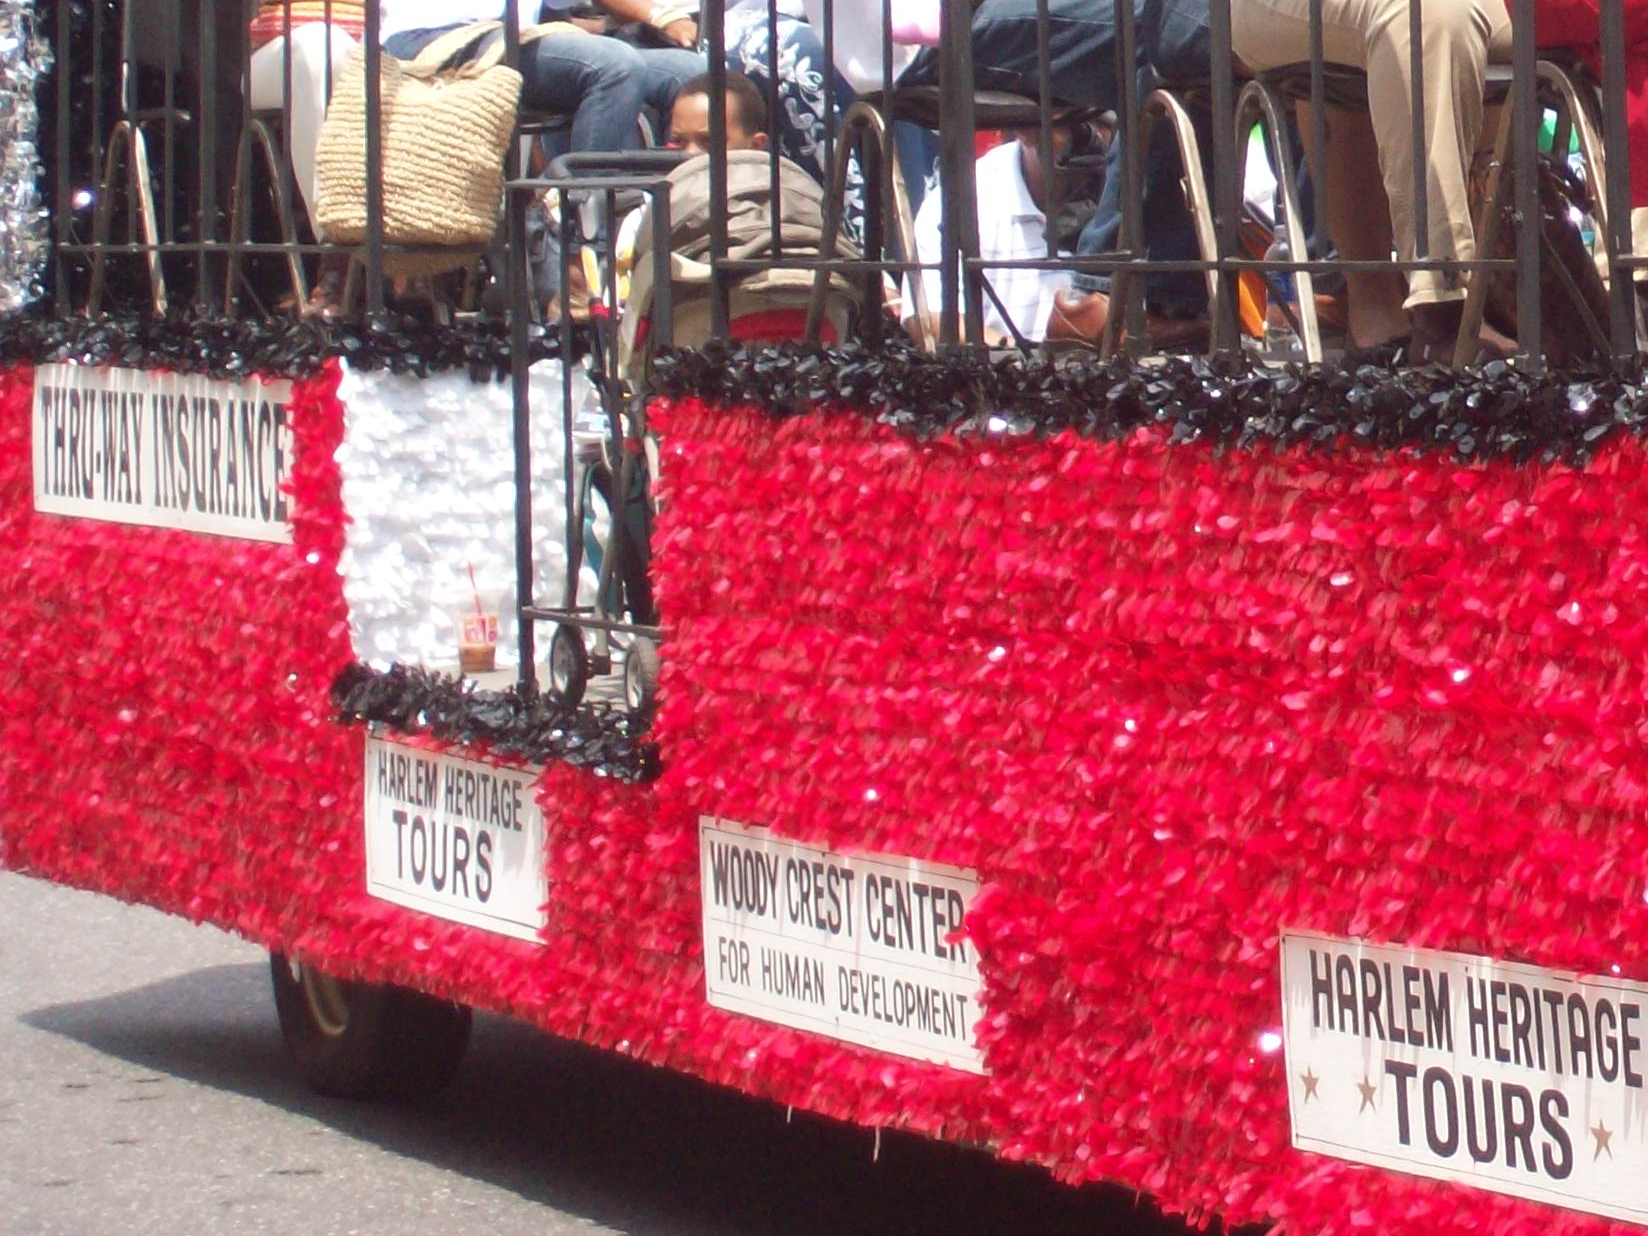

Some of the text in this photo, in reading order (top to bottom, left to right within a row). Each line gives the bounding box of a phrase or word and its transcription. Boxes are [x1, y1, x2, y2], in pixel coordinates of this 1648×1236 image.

[41, 385, 289, 523] THRU-WAY INSURANCE
[378, 749, 523, 832] HARLEM HERITAGE
[392, 809, 493, 904] TOURS
[709, 840, 967, 964] WOODY CREST CENTER
[718, 936, 968, 1042] FOR HUMAN DEVELOPMENT
[1309, 948, 1643, 1089] HARLEM HERITAGE
[1384, 1058, 1574, 1180] TOURS
